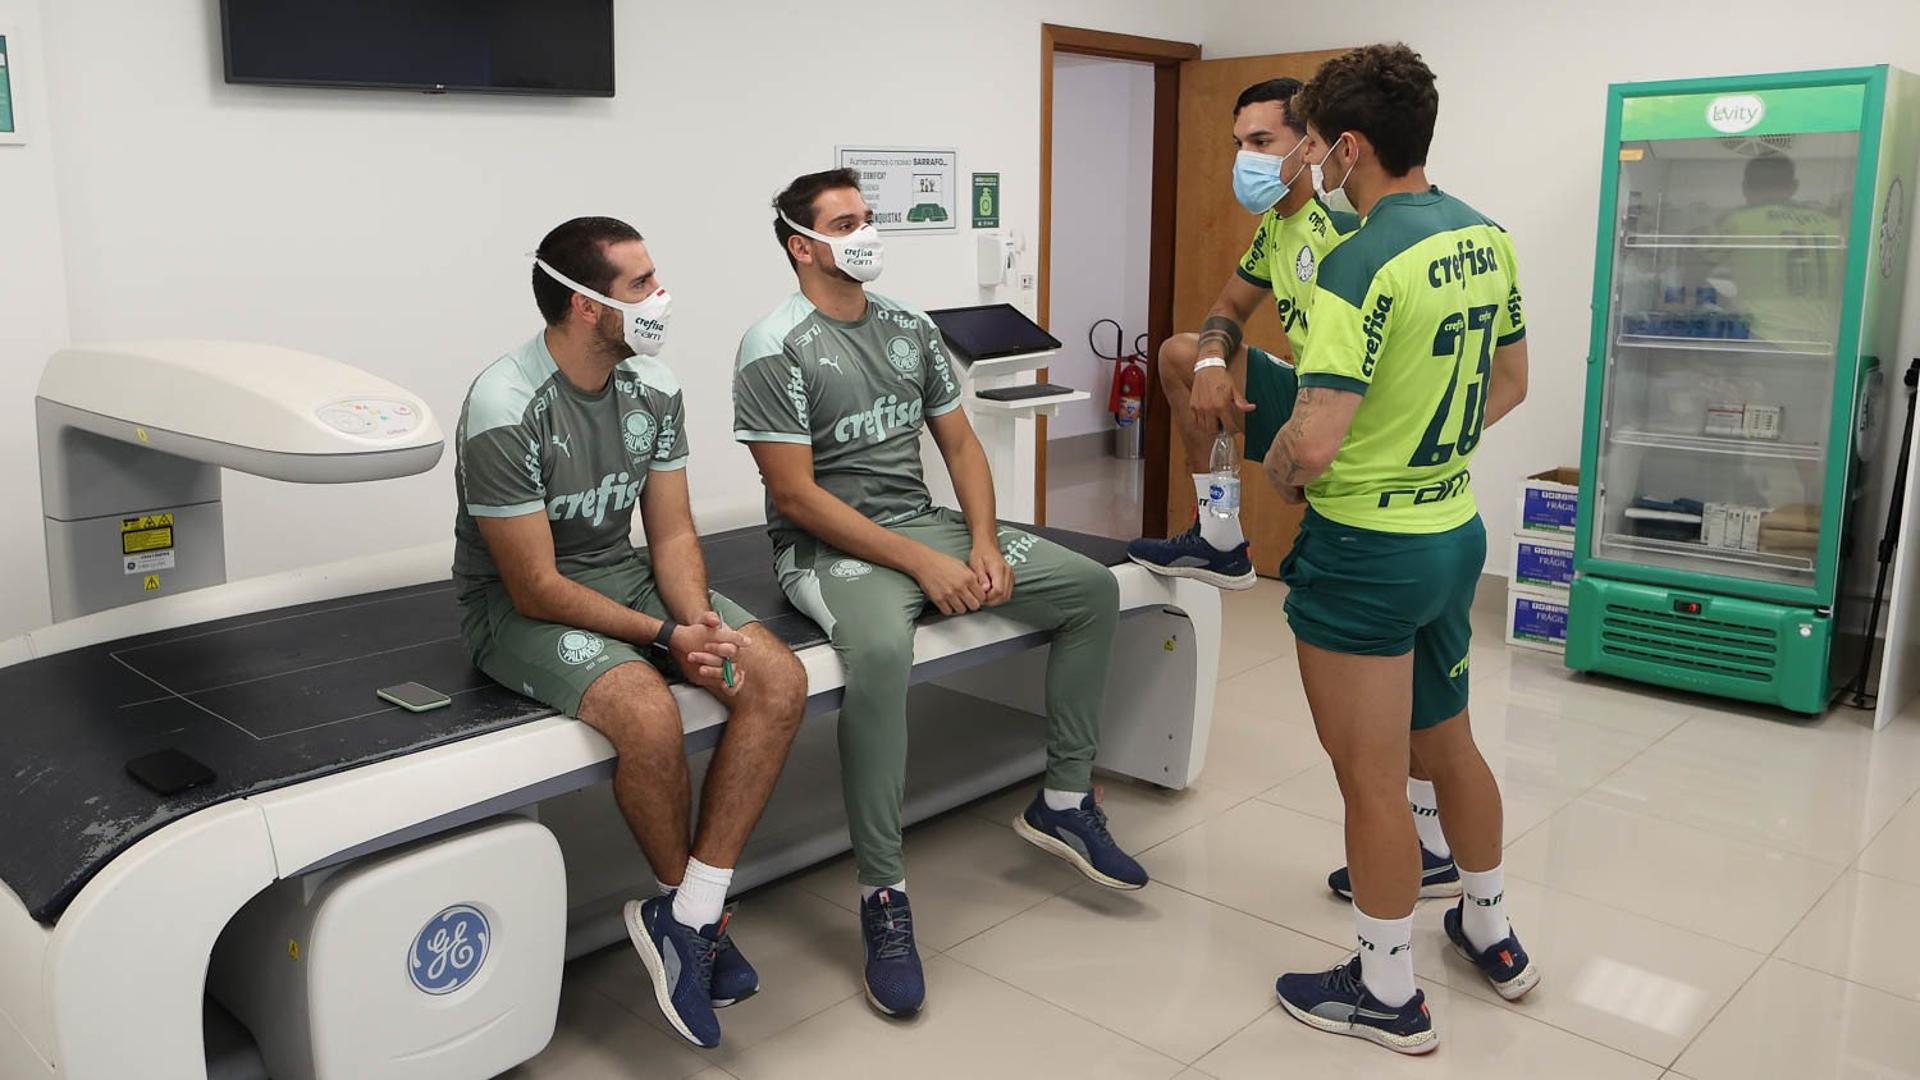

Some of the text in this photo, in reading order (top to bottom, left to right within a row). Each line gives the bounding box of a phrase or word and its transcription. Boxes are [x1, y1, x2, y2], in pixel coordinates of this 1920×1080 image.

[844, 247, 873, 258] crefisa
[1427, 239, 1498, 291] crefisa
[635, 316, 664, 331] crefisa
[1361, 293, 1394, 378] crefisa
[1406, 303, 1500, 468] 23
[835, 394, 924, 443] crefisa
[546, 471, 648, 528] crefis
[1545, 500, 1576, 512] FRÁGIL
[1538, 556, 1568, 568] FRÁGIL
[1535, 612, 1566, 624] FRÁGIL
[427, 920, 474, 980] GE
